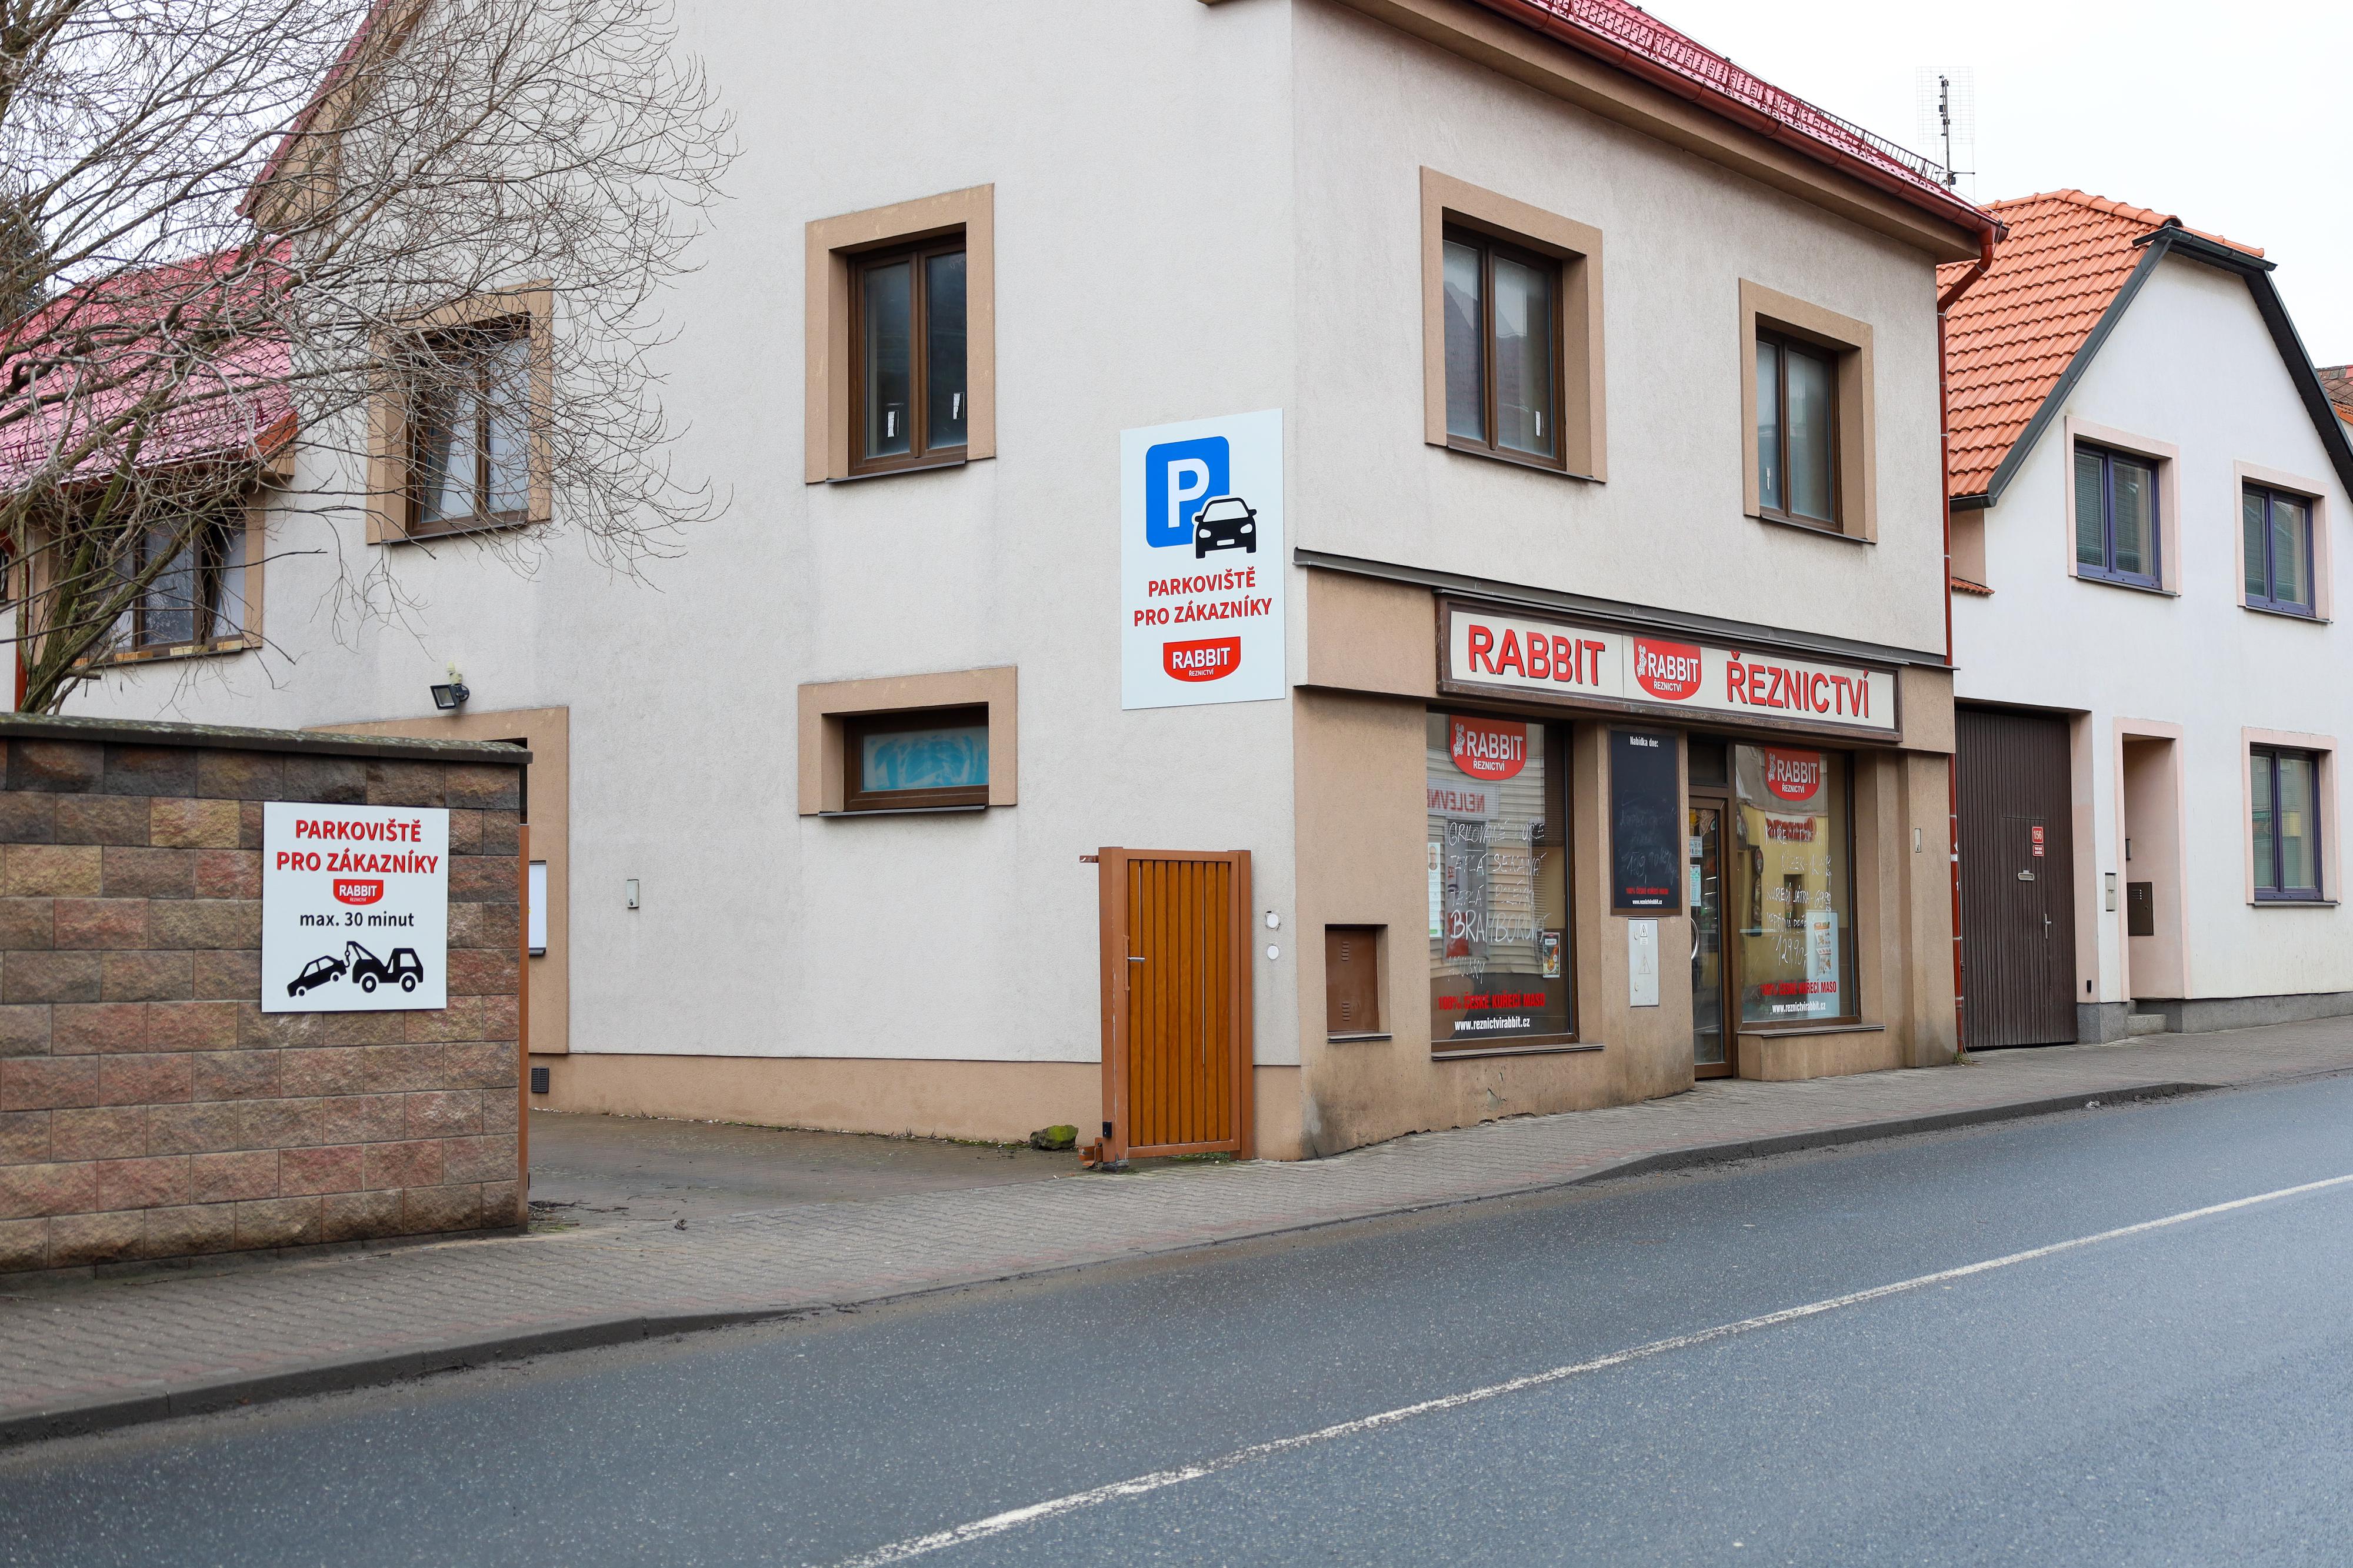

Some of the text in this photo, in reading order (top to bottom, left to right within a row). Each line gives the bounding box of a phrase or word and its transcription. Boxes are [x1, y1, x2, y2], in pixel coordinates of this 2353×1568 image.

[1167, 458, 1210, 528] P
[1148, 566, 1257, 598] PARKOVIŠTĚ
[1134, 594, 1272, 627] PRO ZÁKAZNÍKY
[1172, 647, 1231, 670] RABBIT
[1468, 623, 1606, 687] RABBIT
[1188, 668, 1214, 678] ŘEZNICTVÍ
[1648, 652, 1699, 683] RABBIT
[1653, 679, 1682, 693] ŘEZNICTVÍ
[1726, 649, 1869, 719] ŘEZNICTVÍ
[1466, 730, 1524, 762] RABBIT
[1629, 736, 1659, 748] Nabídka dne:
[1472, 758, 1505, 772] ŘEZNICTVÍ
[1777, 759, 1818, 785] RABBIT
[1781, 782, 1805, 794] ŘEZNICTVÍ
[295, 818, 421, 842] PARKOVIŠTĚ
[2033, 830, 2042, 840] 156
[276, 847, 439, 874] PRO ZÁKAZNÍKY
[339, 885, 378, 897] RABBIT
[299, 910, 415, 928] max. 30 minut
[1450, 909, 1552, 943] BRAMBOROVÁ
[1799, 979, 1819, 995] KUŘECÍ
[1821, 980, 1837, 993] MASO
[1438, 990, 1546, 1010] 100% ČESKÉ KUŘECÍ MASO
[1771, 1000, 1826, 1013] www.reznictvirabbit.cz
[1454, 1016, 1530, 1030] www.reznictvirabbit.cz
